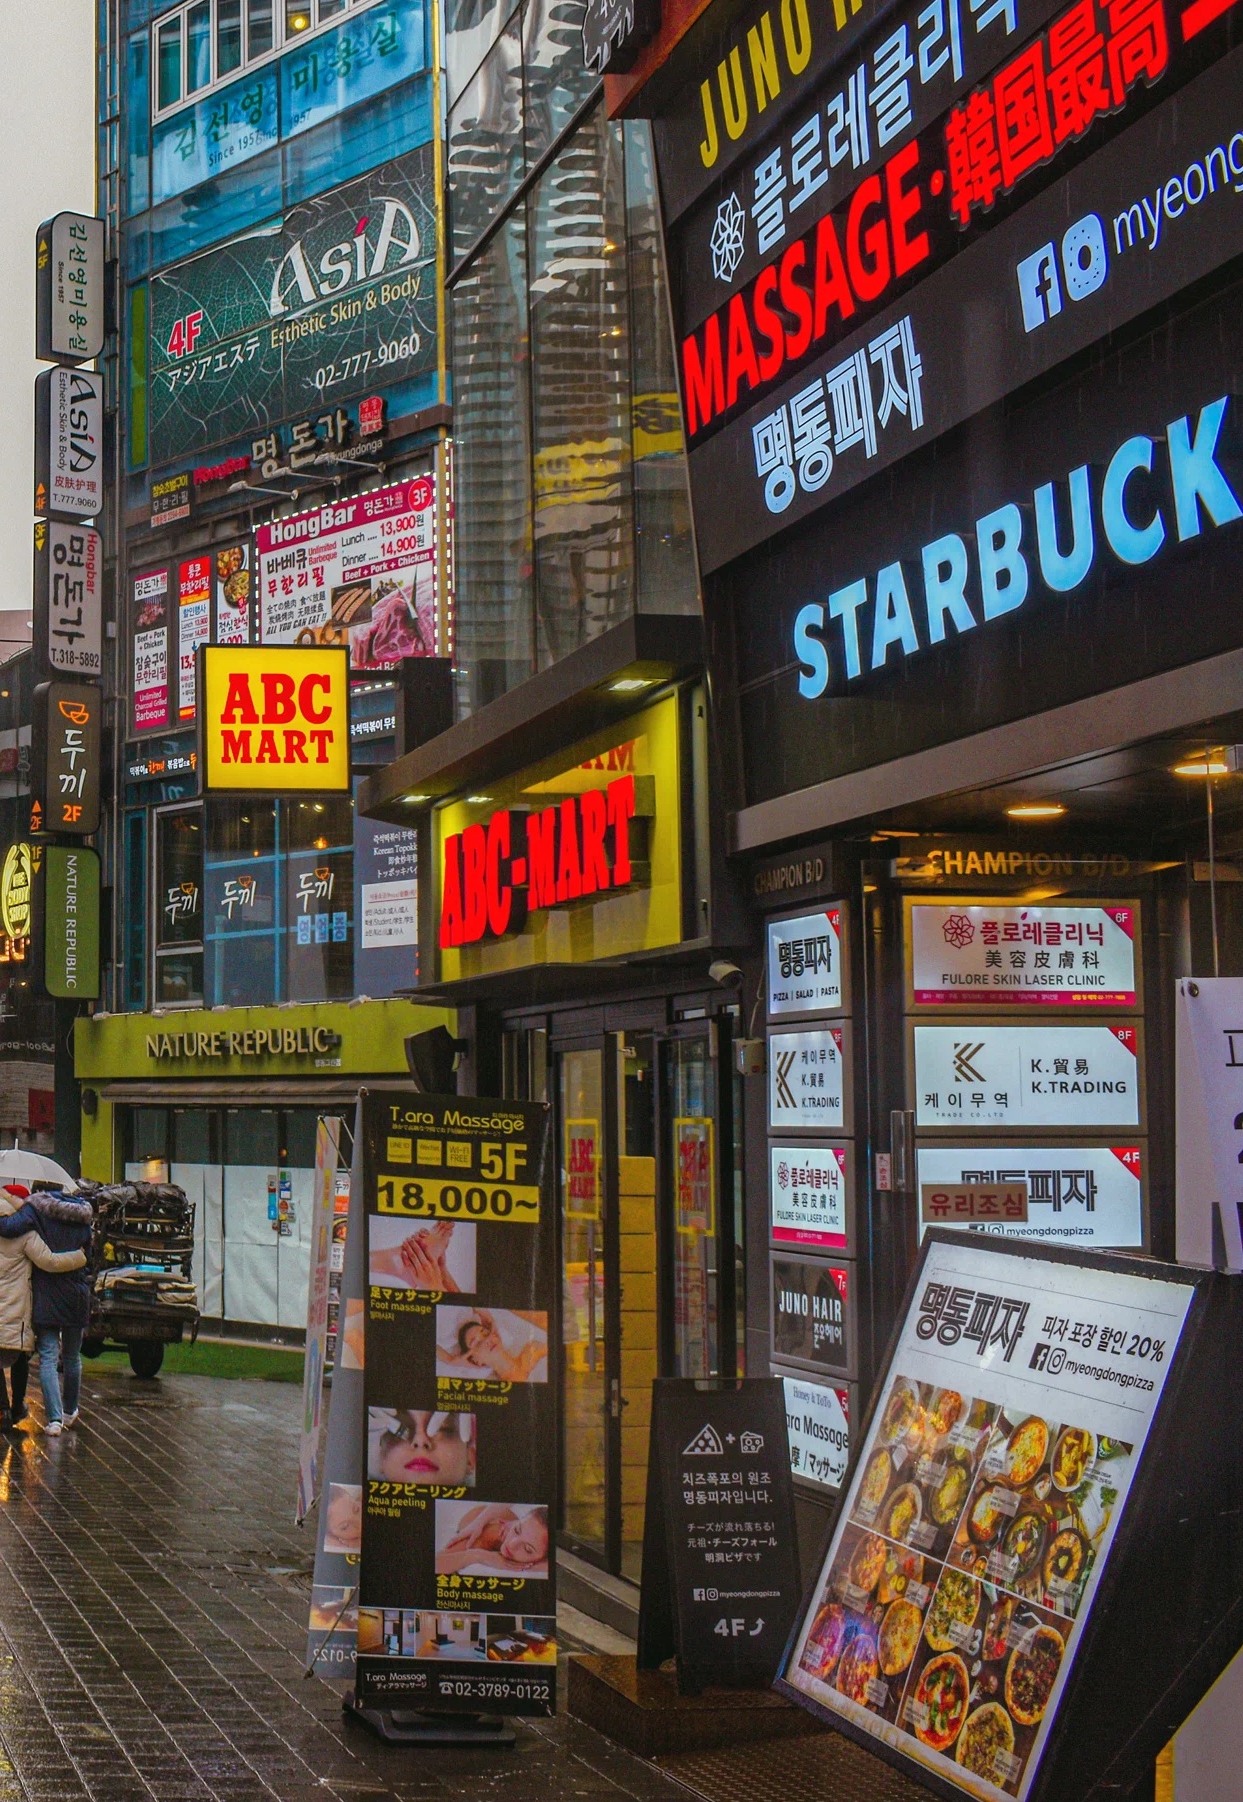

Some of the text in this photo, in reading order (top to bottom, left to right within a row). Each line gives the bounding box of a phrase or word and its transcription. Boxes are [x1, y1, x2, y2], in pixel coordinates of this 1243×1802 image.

[68, 222, 88, 351] 김선영미용실
[271, 274, 421, 349] Esthetic Skin Body
[167, 309, 203, 359] 4F
[168, 336, 261, 392] アジアエステ
[315, 332, 420, 390] 02-777-9060
[57, 372, 67, 471] Esthetic Skin Body
[752, 315, 924, 514] 명동피자
[55, 476, 97, 493] 皮肤护理
[53, 494, 97, 508] T.777.9060
[412, 487, 427, 506] 3F
[270, 504, 357, 545] HongBar
[308, 542, 336, 556] Unlimited
[341, 532, 365, 547] Lunch
[793, 395, 1243, 700] STARBUCK
[85, 533, 98, 594] Hongbar
[267, 548, 306, 575] 바베큐
[308, 551, 338, 566] Barbeque
[342, 552, 367, 567] Dinner
[344, 551, 430, 581] Beef Pork Chicken
[52, 648, 100, 668] T.318-5892
[220, 672, 333, 724] ABC
[136, 709, 166, 722] Barbeque
[221, 729, 334, 764] MART
[59, 728, 87, 798] 두끼
[62, 804, 82, 822] 2F
[30, 816, 42, 831] 2F
[31, 845, 42, 859] 1F
[439, 774, 635, 950] ABC-MART
[805, 858, 823, 884] B/D
[927, 850, 1076, 877] CHAMPION
[221, 879, 256, 919] 두끼
[296, 872, 335, 913] 두끼
[165, 887, 199, 925] 두끼
[66, 855, 77, 989] NATURE REPUBLIC
[1115, 912, 1128, 923] 6F
[980, 921, 1104, 946] 플로레클리닉
[986, 950, 1100, 970] 美容皮膚科
[942, 974, 1105, 985] FULORE SKIN LASER CLINIC
[773, 985, 839, 1002] PIZZA SALAD PASTA
[145, 1027, 330, 1058] NATURE REPUBLIC
[1118, 1031, 1132, 1040] 8F
[1032, 1081, 1127, 1094] K.TRADING
[801, 1095, 839, 1109] K.TRADING
[924, 1093, 1009, 1109] 케이무역
[389, 1106, 434, 1125] T.ara
[443, 1109, 525, 1134] Massage
[450, 1155, 469, 1163] FREE
[480, 1141, 527, 1181] 5F
[1122, 1151, 1139, 1163] 4F
[791, 1168, 839, 1190] 플로레클리닉
[929, 1193, 1025, 1217] 유리조심
[1007, 1226, 1094, 1237] myeongdongpizza
[370, 1286, 443, 1303] 足マッサージ
[370, 1300, 432, 1315] Foot massage
[779, 1290, 842, 1323] JUNO HAIR
[915, 1281, 1031, 1363] 명동피자
[1042, 1315, 1167, 1362] 피자 포장 할인 20%
[1065, 1359, 1154, 1392] myeongdongpizza
[437, 1391, 509, 1405] Facial massage
[803, 1414, 849, 1449] Massage
[682, 1471, 771, 1486] 치즈폭포의 원조
[368, 1495, 426, 1509] Aqua peeling
[683, 1489, 773, 1505] 명동피자입니다.
[436, 1574, 526, 1591] 全身マッサージ
[436, 1588, 504, 1602] Body massage
[719, 1589, 781, 1600] myeongdongpizza
[714, 1618, 745, 1637] 4F
[389, 1672, 427, 1682] Massage
[455, 1682, 550, 1700] 02-3789-0122
